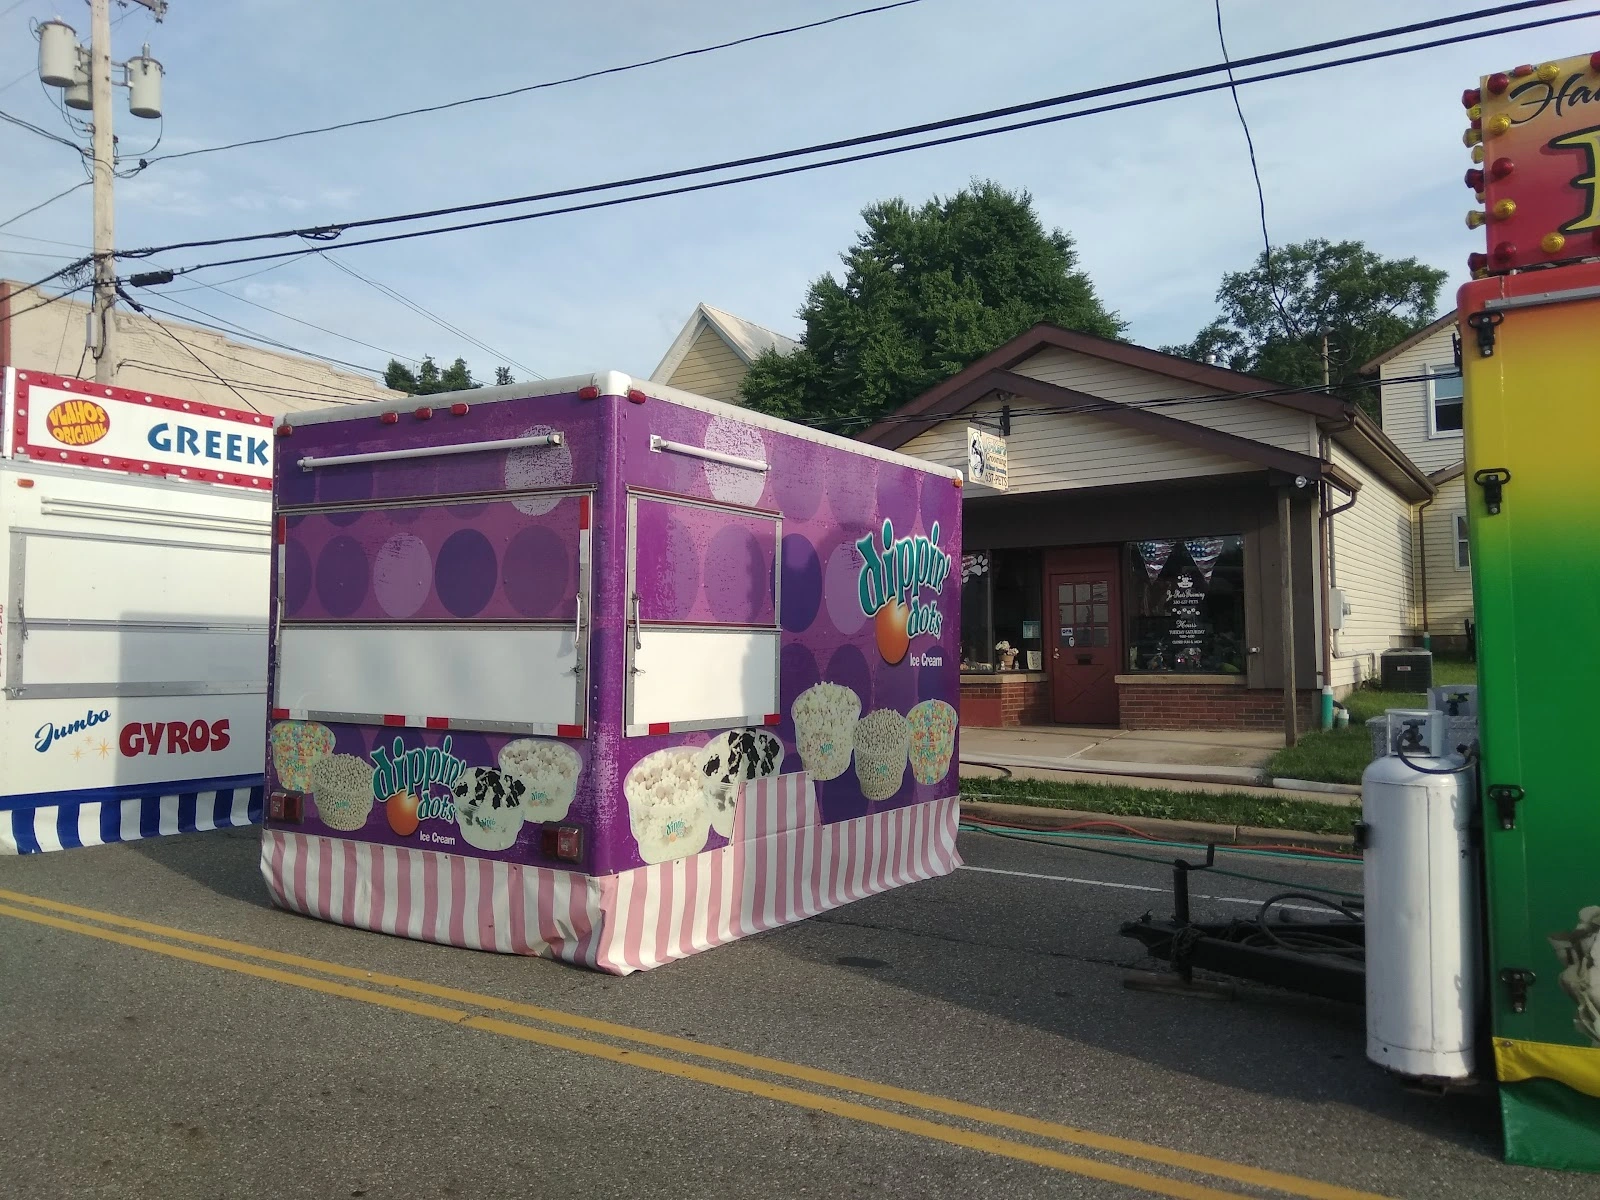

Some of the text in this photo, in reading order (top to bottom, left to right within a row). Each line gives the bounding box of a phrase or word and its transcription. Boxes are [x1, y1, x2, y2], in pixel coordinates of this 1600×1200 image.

[1509, 73, 1600, 125] Ha
[49, 401, 106, 426] VLAHOS
[52, 422, 107, 445] ORIGINAL
[147, 422, 270, 466] GREEK
[906, 597, 943, 639] dots
[910, 652, 943, 667] Ice Cream
[34, 708, 112, 753] Jumbo
[119, 718, 231, 758] GYROS
[417, 791, 456, 824] dots
[420, 831, 456, 846] Ice Cream
